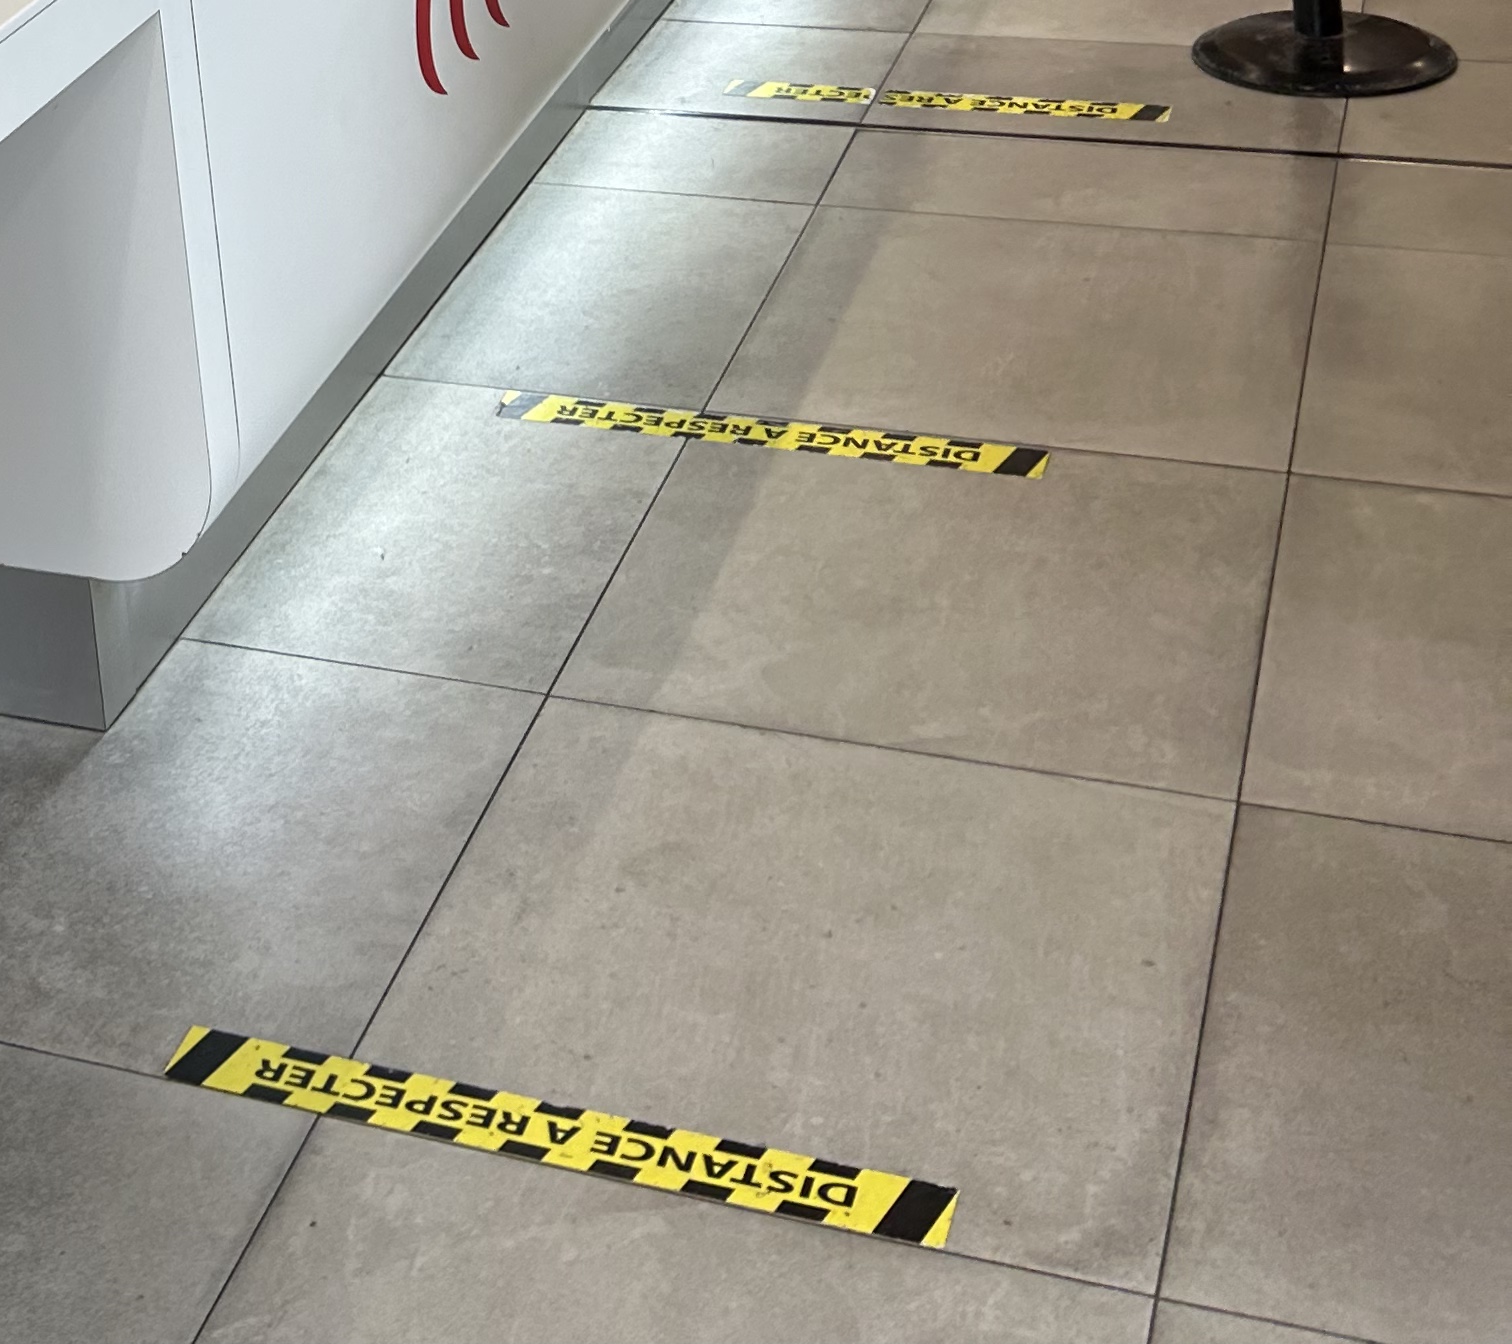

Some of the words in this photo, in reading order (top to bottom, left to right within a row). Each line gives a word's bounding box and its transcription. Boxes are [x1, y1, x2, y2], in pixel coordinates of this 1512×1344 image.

[556, 403, 747, 438] RESPECTER
[795, 430, 983, 464] DISTANCE
[253, 1055, 521, 1138] RESPECTER
[590, 1129, 860, 1210] DISTANCE
